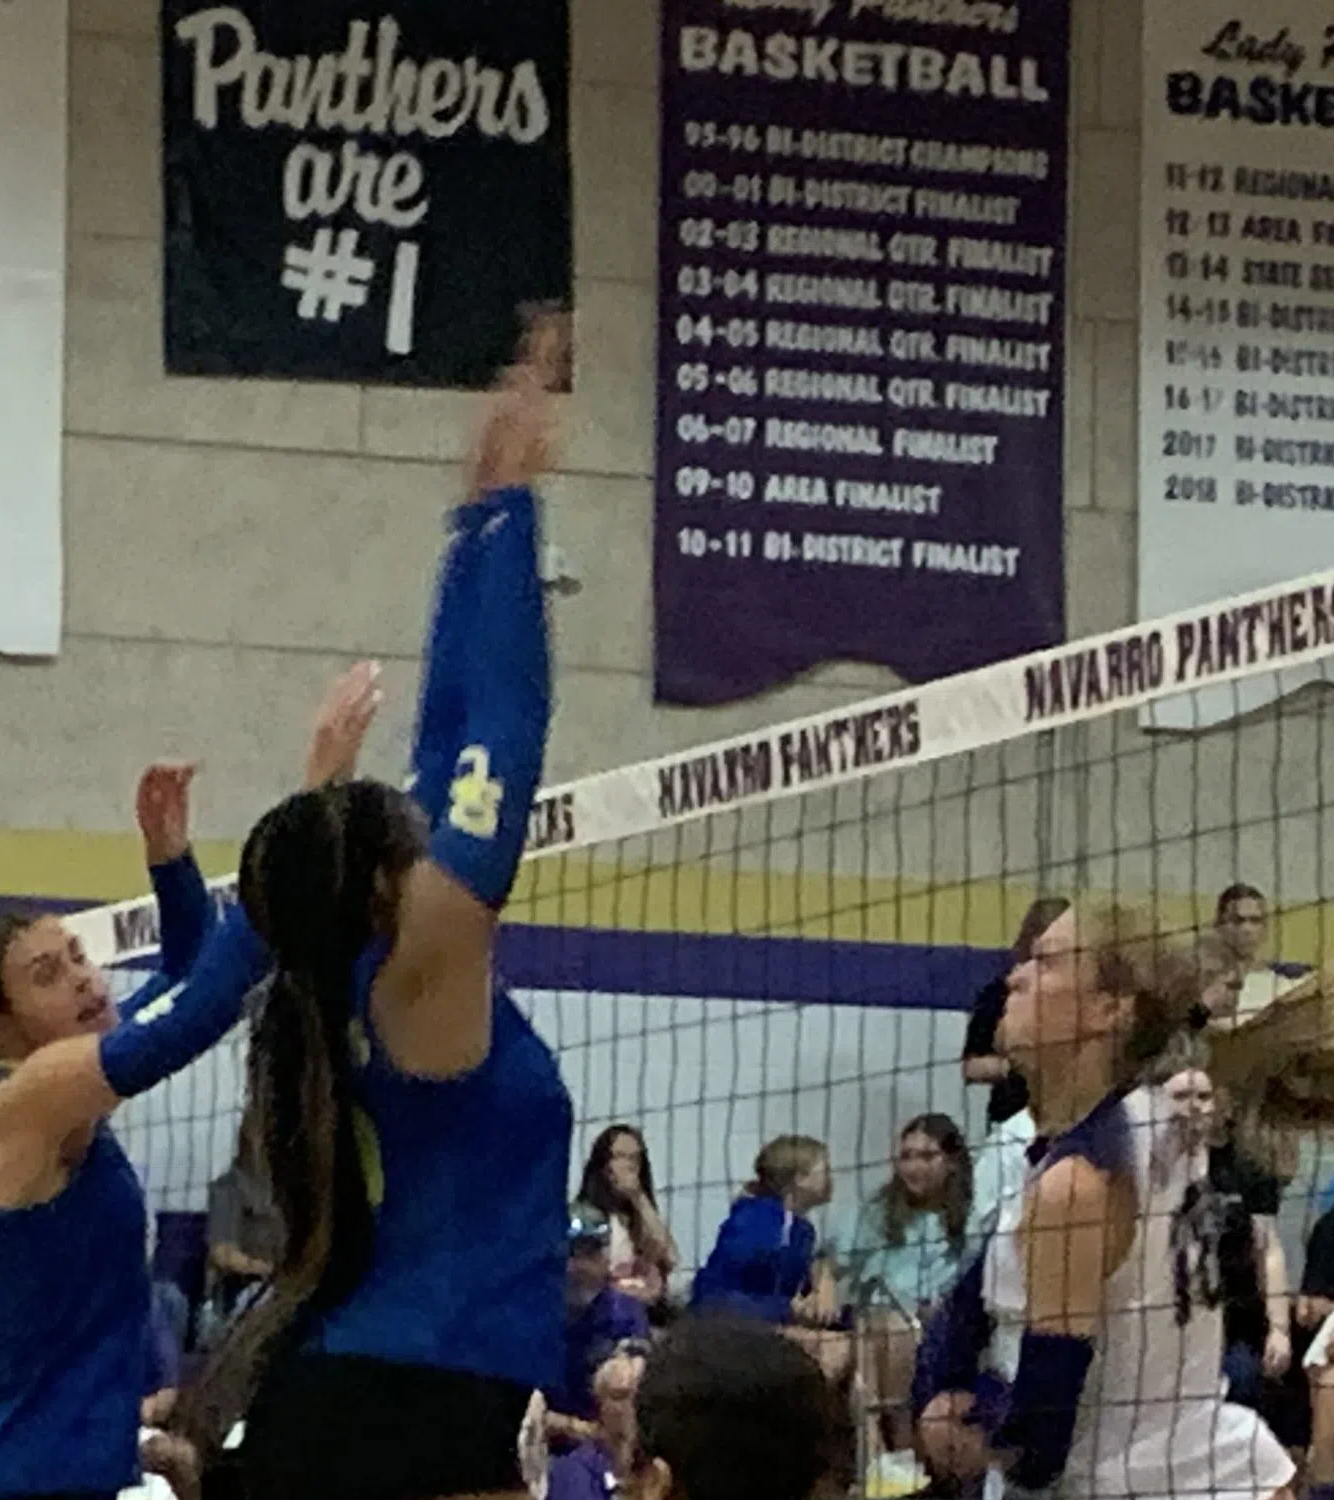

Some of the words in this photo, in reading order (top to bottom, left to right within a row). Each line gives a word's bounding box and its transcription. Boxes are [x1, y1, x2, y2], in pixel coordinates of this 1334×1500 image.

[679, 26, 1049, 102] BASKETBALL
[1201, 19, 1306, 77] Lady
[175, 5, 549, 144] Panthers
[284, 140, 427, 228] are
[1242, 214, 1302, 245] AREA
[281, 228, 419, 355] #1
[946, 284, 1054, 325] FINALIST
[945, 334, 1052, 372] FINALIST
[765, 367, 882, 404] REGIONAL
[945, 379, 1051, 418] FINALIST
[677, 413, 757, 445] 06-07
[766, 417, 883, 457] REGIONAL
[893, 427, 998, 465] FINALIST
[1164, 431, 1216, 460] 2017
[676, 466, 755, 500] 09-10
[764, 474, 828, 506] AREA
[834, 480, 942, 515] FINALIST
[1164, 475, 1217, 503] 2018
[677, 527, 752, 557] 10-11
[912, 541, 1020, 578] FINALIST
[1024, 631, 1163, 723] NAVARRO
[658, 740, 771, 819] NAVARRO
[779, 698, 921, 787] PANTHERS
